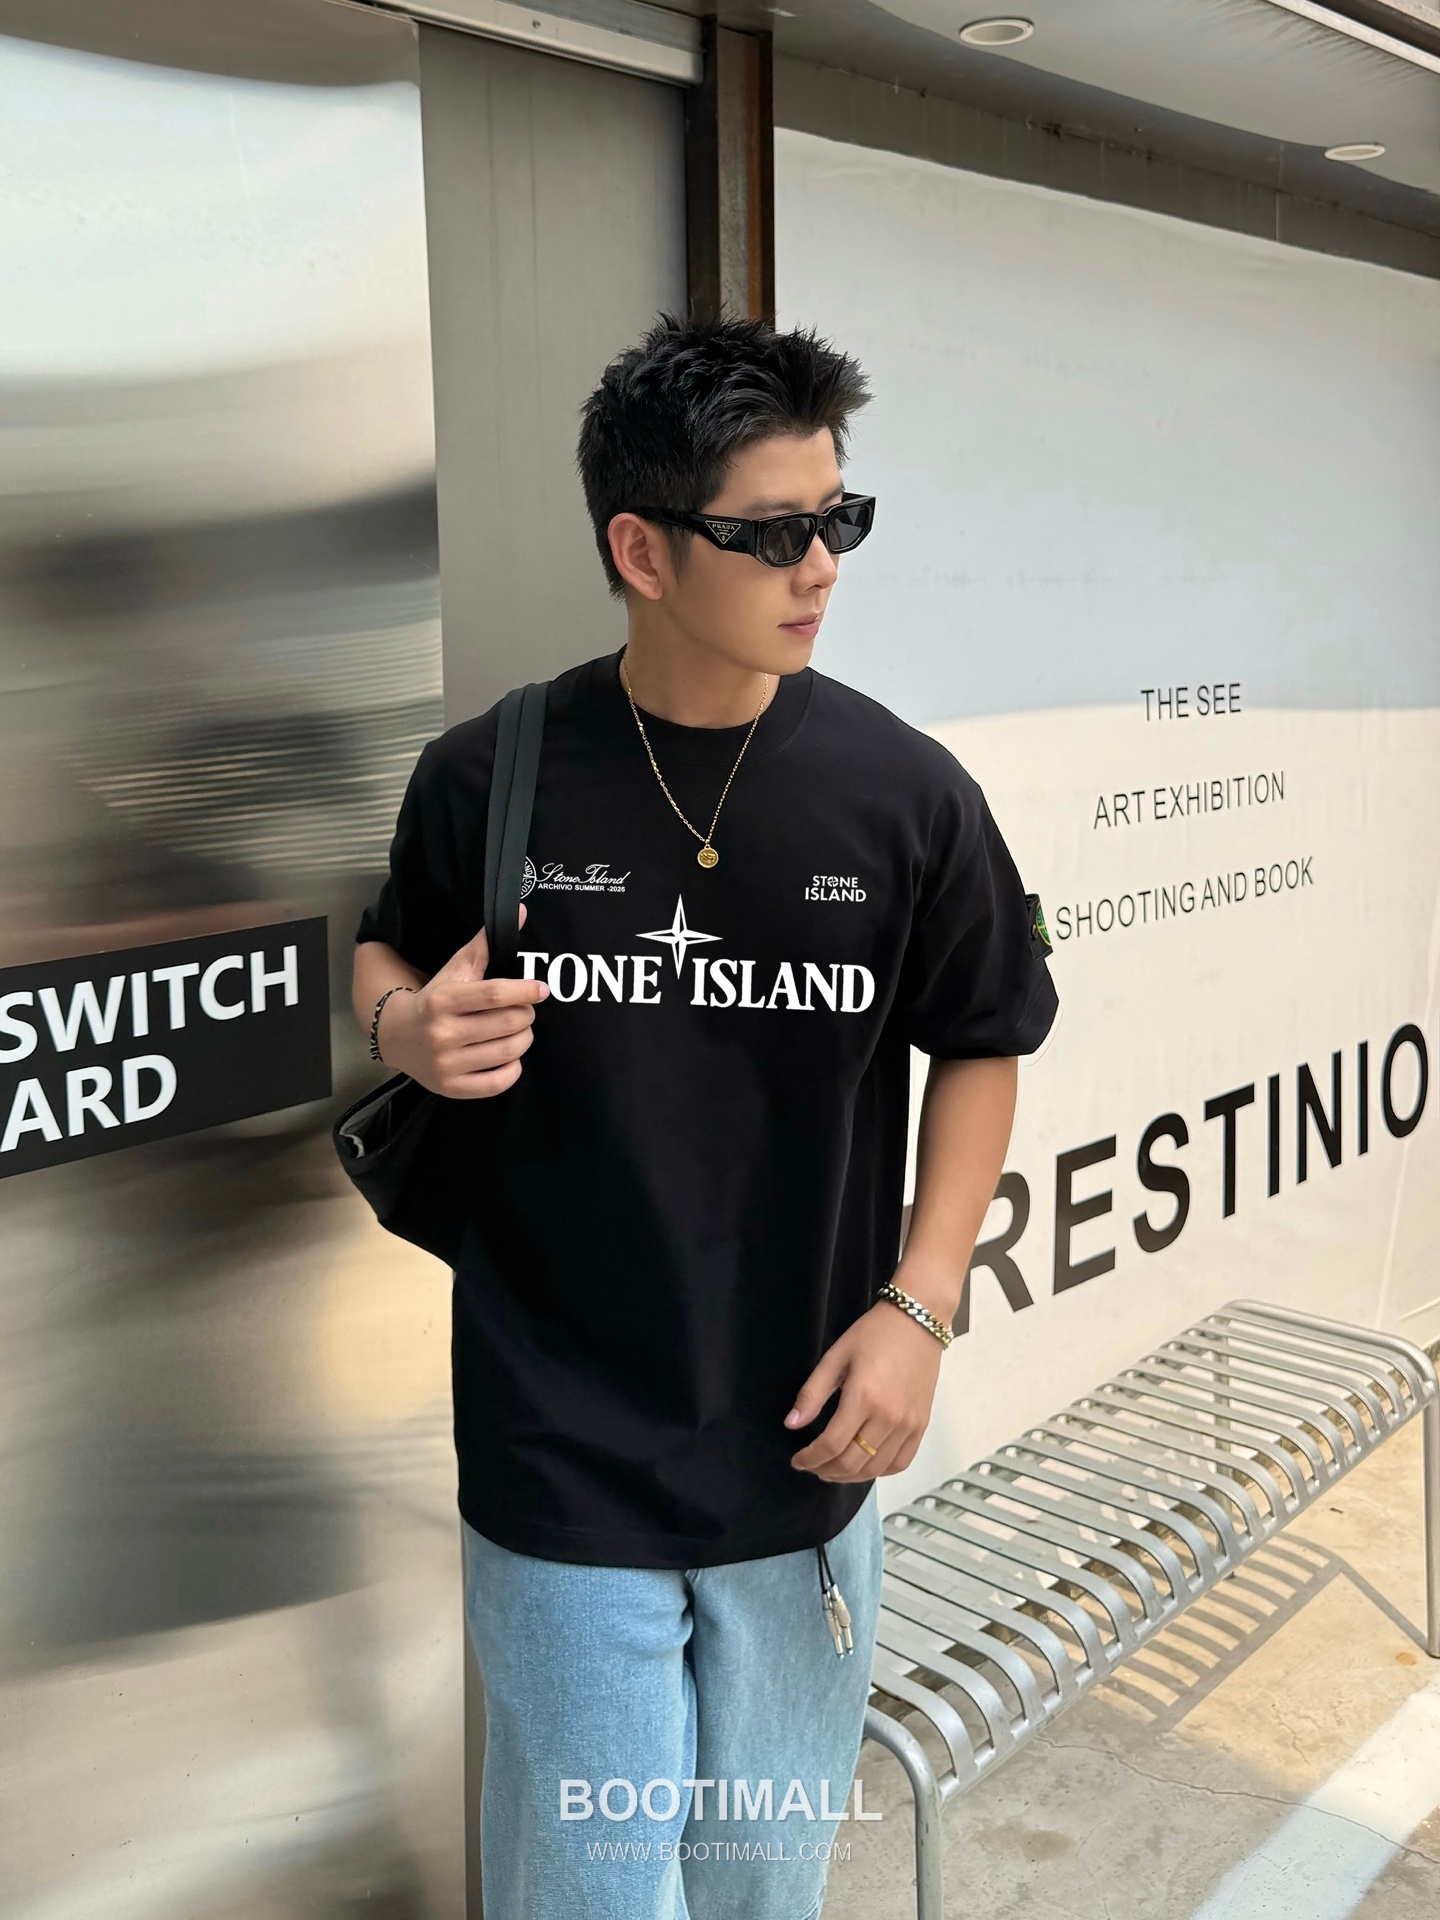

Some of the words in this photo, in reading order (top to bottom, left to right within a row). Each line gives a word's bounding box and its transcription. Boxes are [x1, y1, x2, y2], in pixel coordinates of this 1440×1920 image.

[1140, 687, 1189, 721] THE
[1196, 683, 1241, 716] SEE
[1094, 791, 1145, 829] ART
[1153, 770, 1285, 820] EXHIBITION
[537, 863, 580, 883] Stone
[805, 887, 867, 902] ISLAND
[812, 875, 858, 888] STONE
[1056, 882, 1195, 940] SHOOTING
[1201, 872, 1247, 910] AND
[1255, 855, 1313, 897] BOOK
[0, 945, 299, 1064] SWITCH
[690, 957, 875, 1013] ISLAND
[0, 1054, 178, 1151] ARD
[901, 1022, 1429, 1338] RESTINIO
